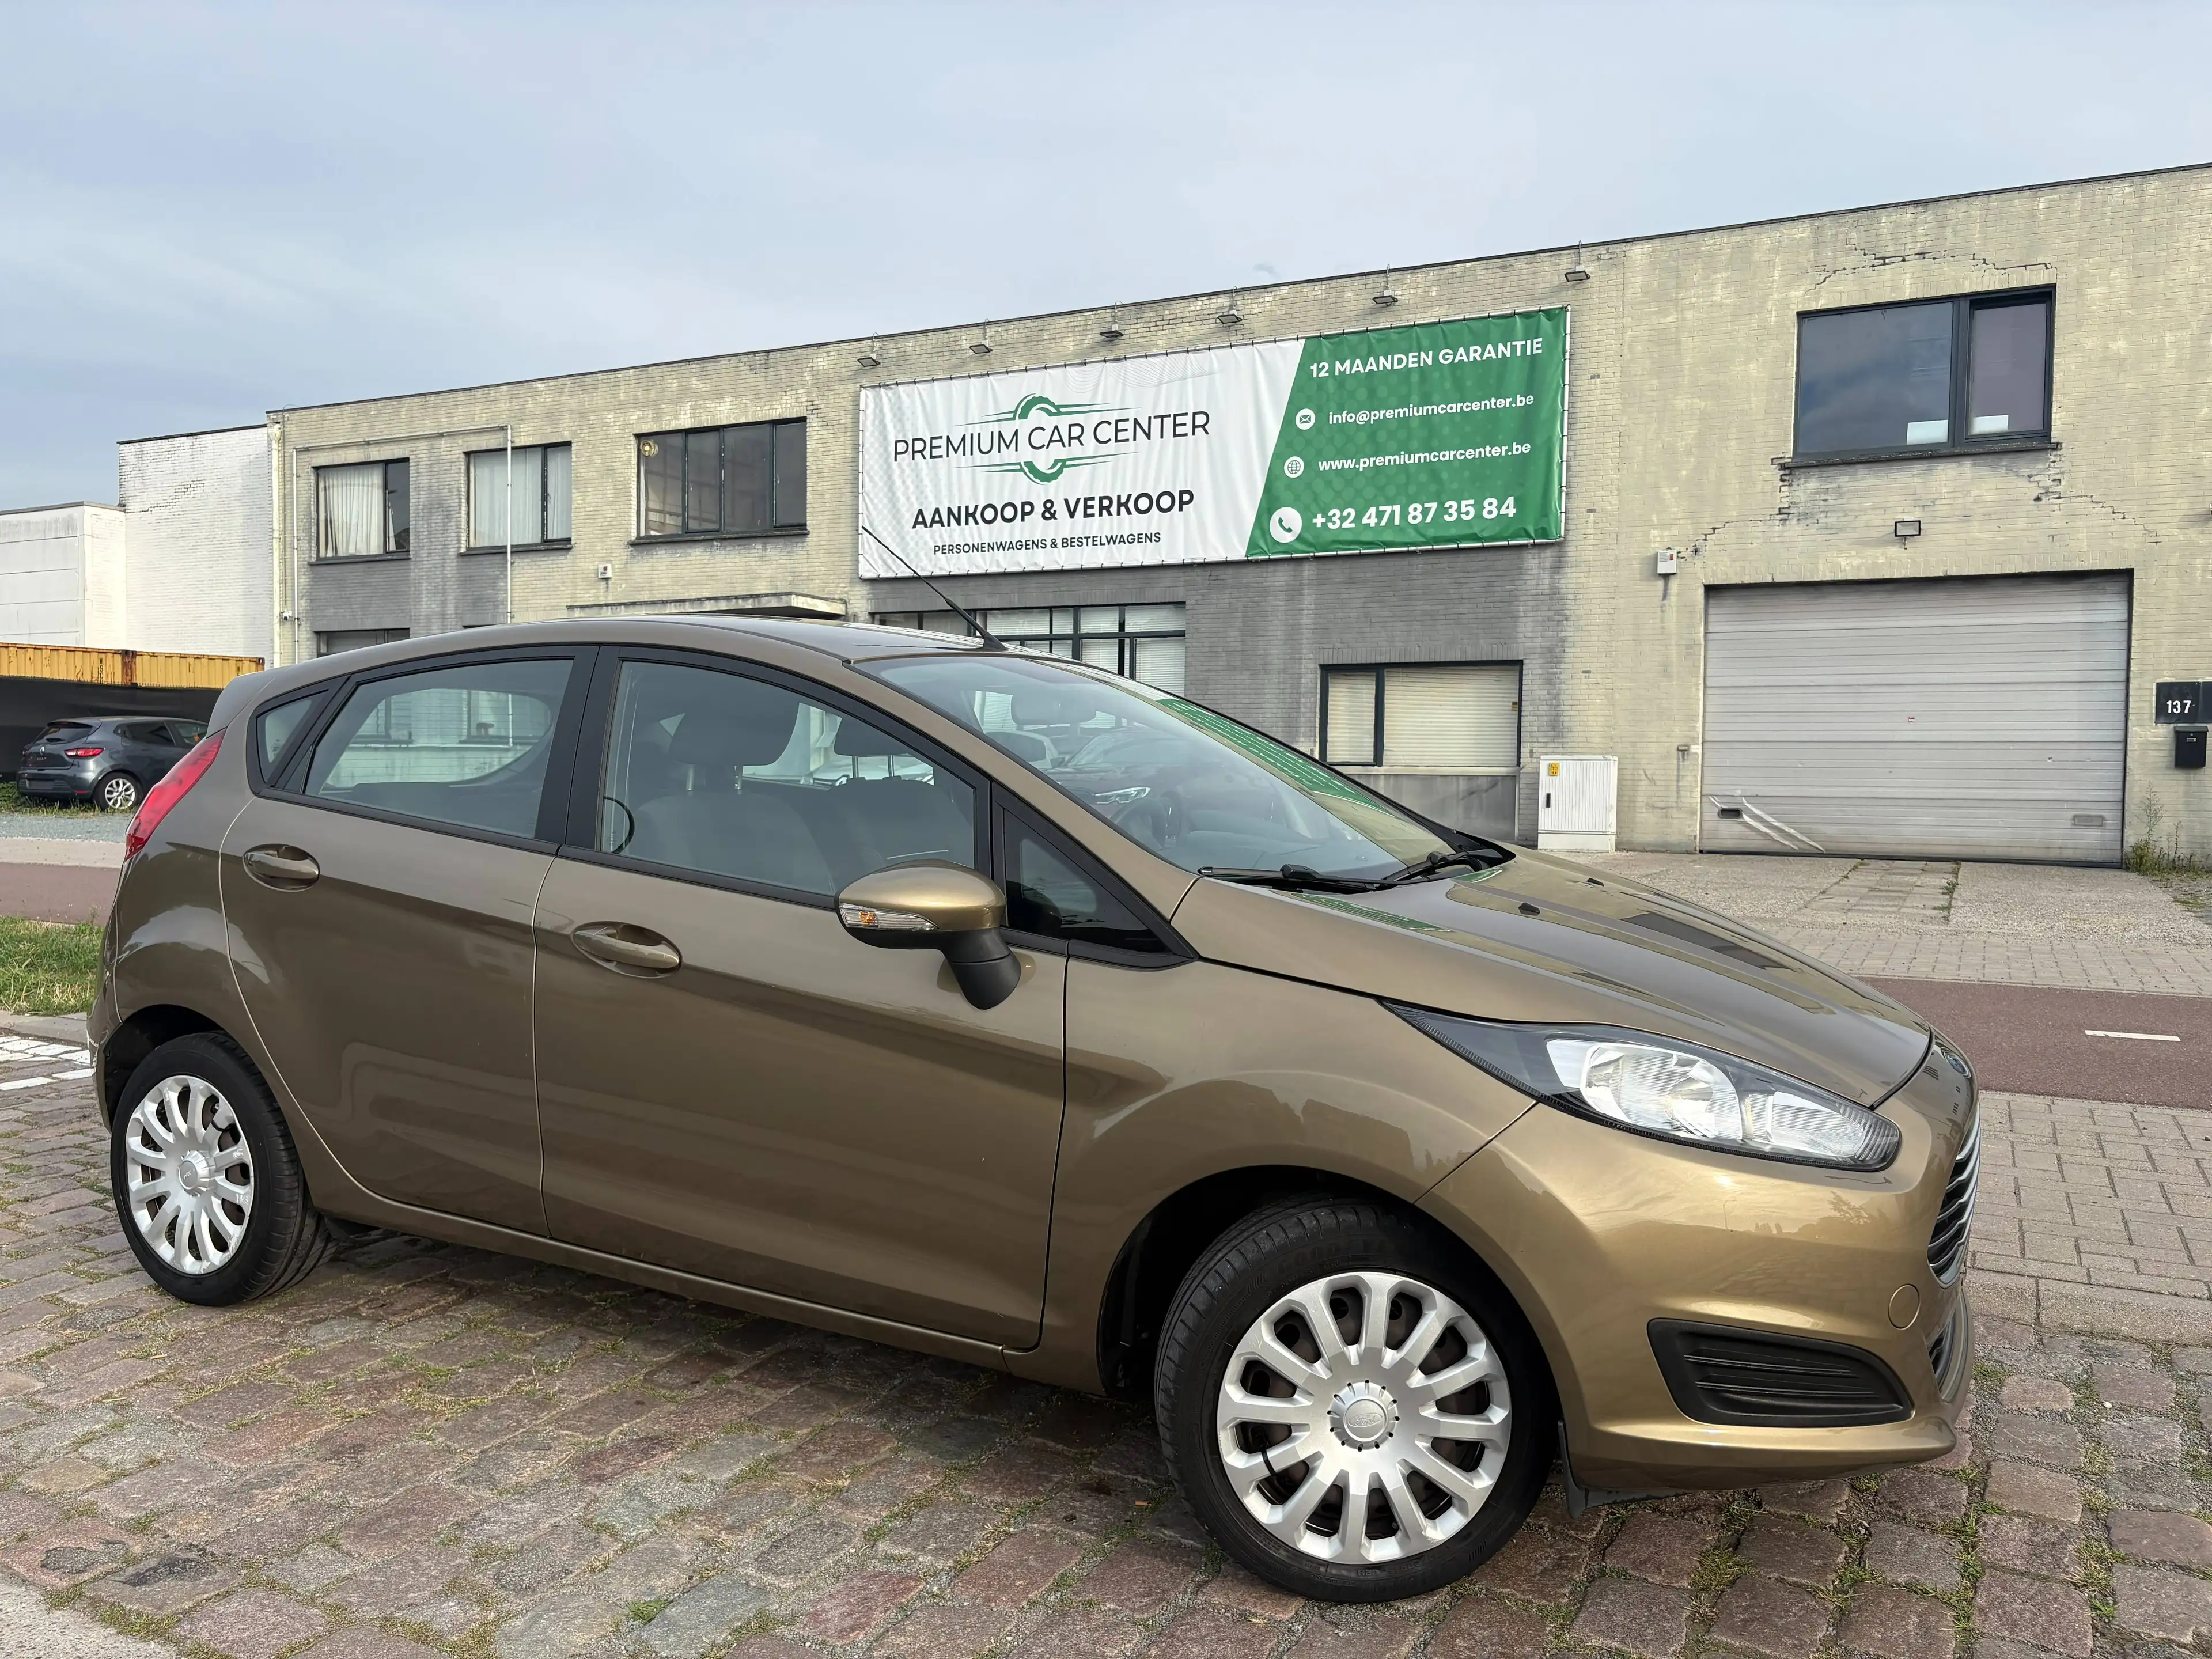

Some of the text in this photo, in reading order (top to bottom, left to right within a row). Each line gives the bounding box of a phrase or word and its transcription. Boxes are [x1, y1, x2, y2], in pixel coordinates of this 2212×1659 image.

[1310, 338, 1543, 378] 12 MAANDEN GARANTIE
[1329, 394, 1534, 425] info@premiumcarcenter.be
[894, 411, 1210, 462] PREMIUM CAR CENTER
[1318, 442, 1531, 472] www.premiumcarcenter.be
[912, 489, 1194, 529] AANKOOP & VERKOOP
[1312, 496, 1516, 529] +32 471 87 35 84
[934, 532, 1161, 555] PERSONENWAGENS & BESTELWAGENS
[2166, 700, 2191, 714] 137
